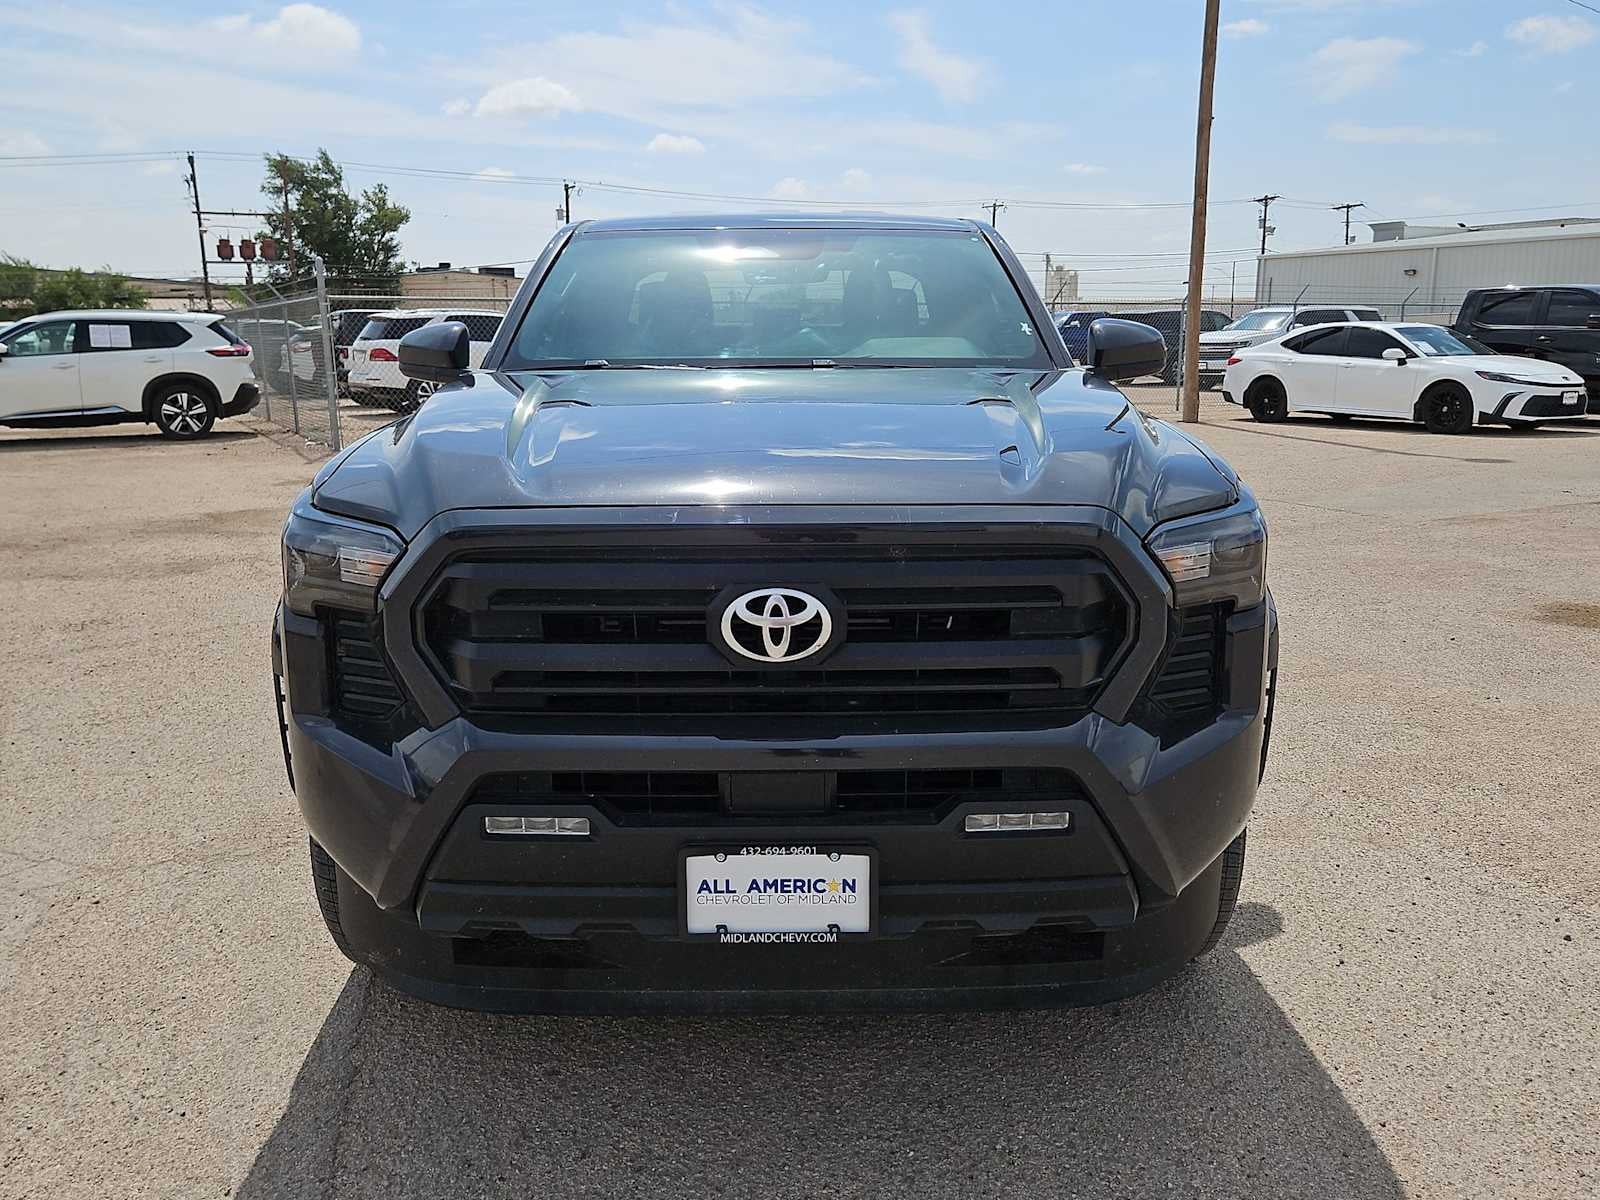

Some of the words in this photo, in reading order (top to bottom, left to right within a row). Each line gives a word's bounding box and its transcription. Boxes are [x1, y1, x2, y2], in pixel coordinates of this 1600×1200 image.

[739, 846, 817, 856] 432-694-9601
[697, 878, 737, 894] ALL
[746, 878, 857, 894] AMERICN
[696, 894, 774, 905] CHEVROLET
[776, 894, 794, 905] OF
[798, 894, 857, 905] MIDLAND
[720, 932, 837, 944] MIDLANDCHEVY.COM
